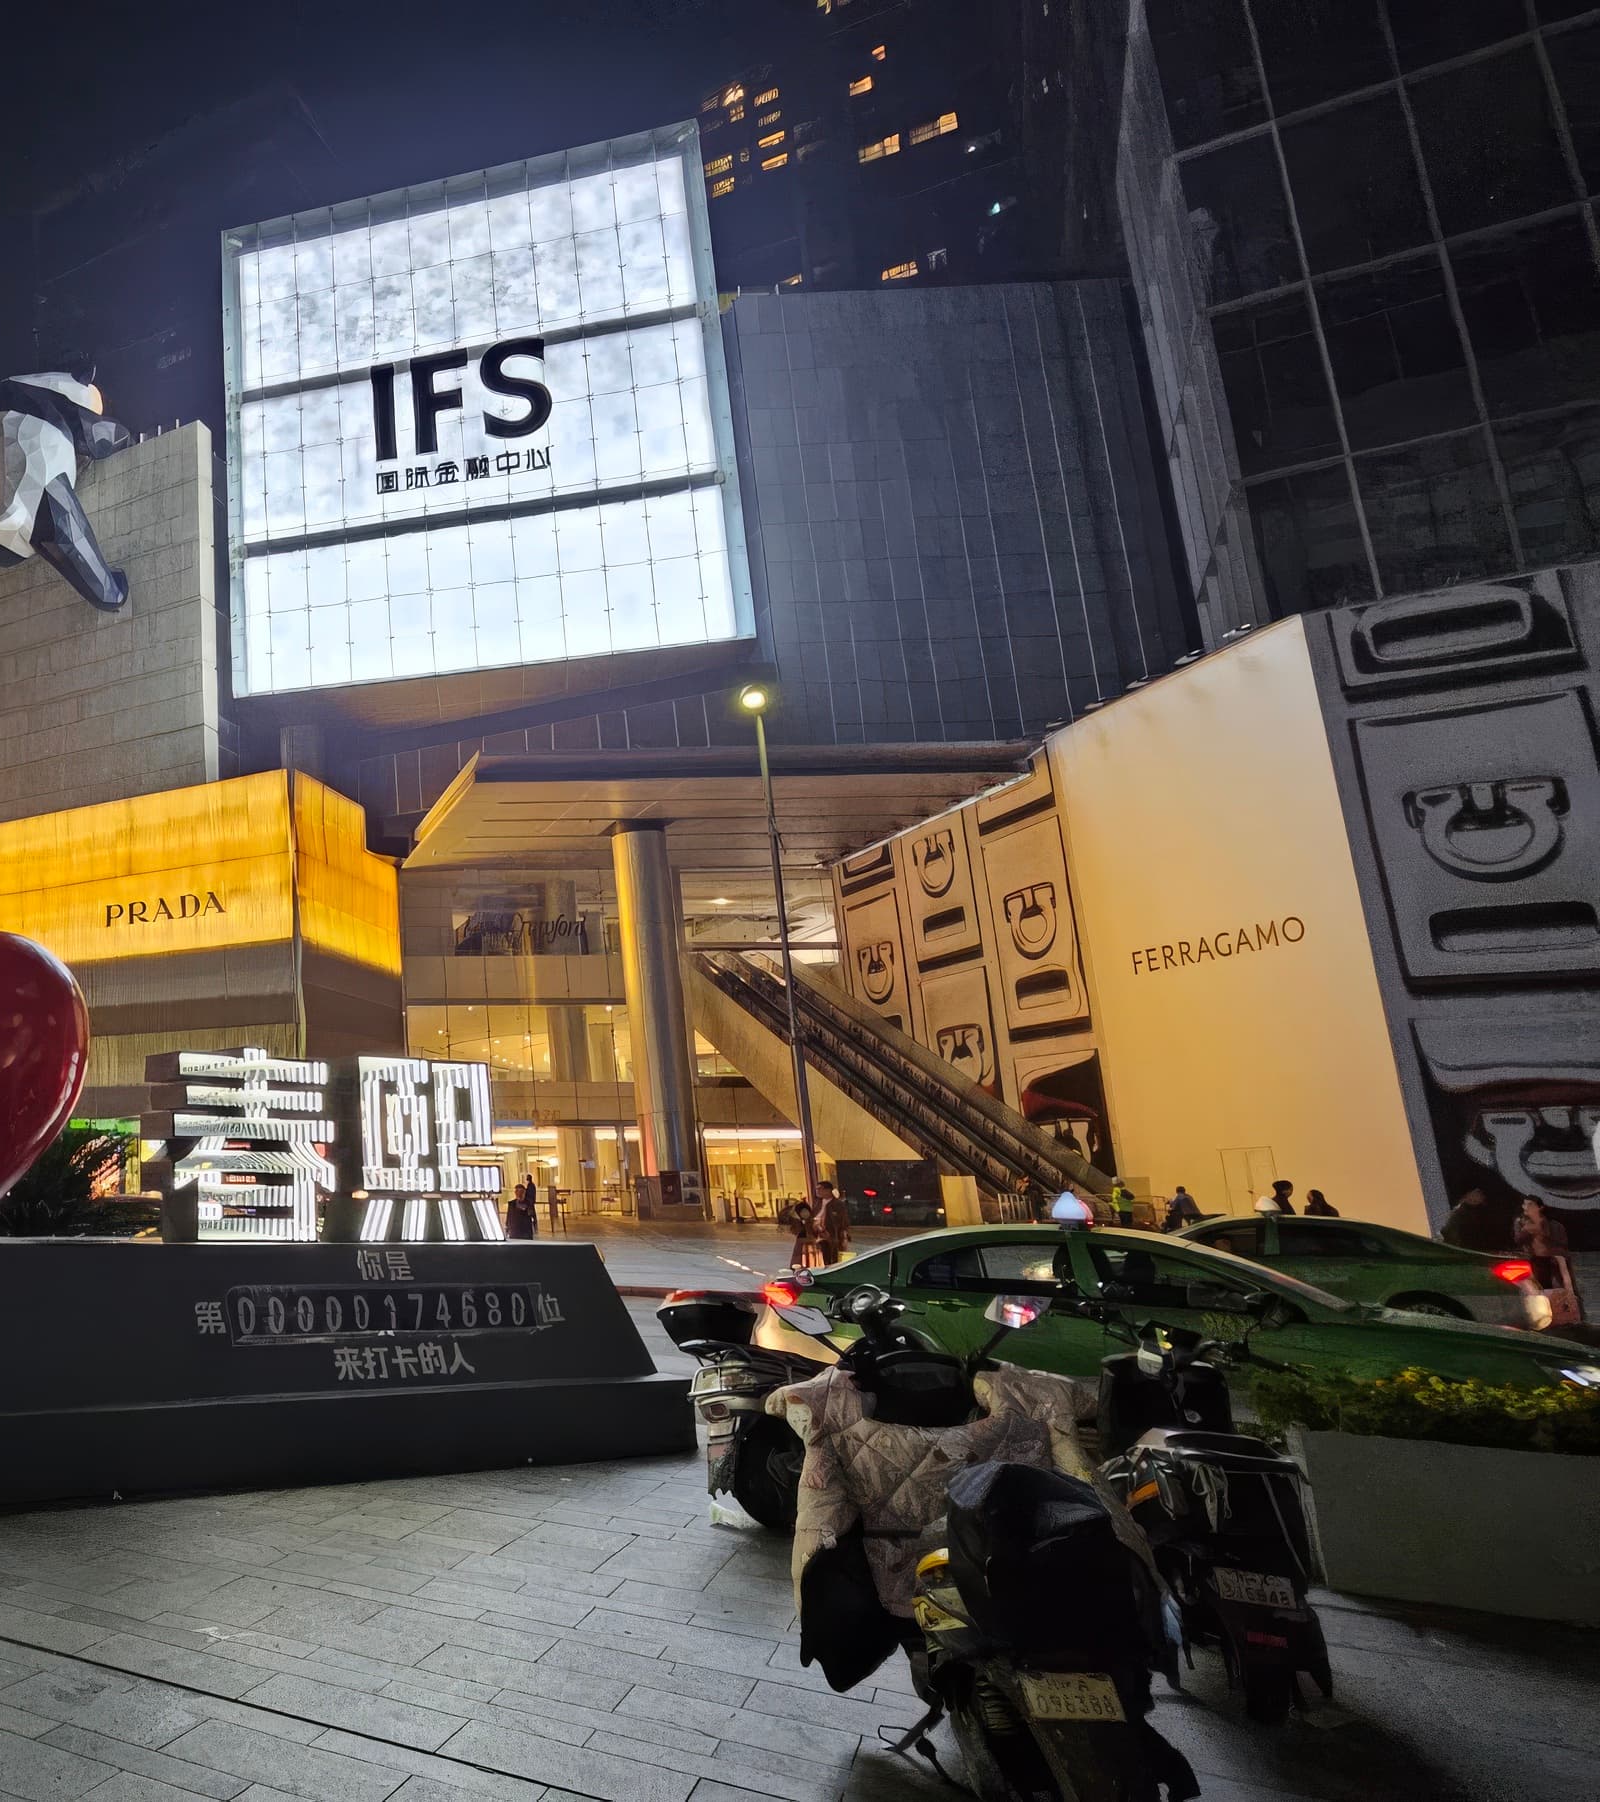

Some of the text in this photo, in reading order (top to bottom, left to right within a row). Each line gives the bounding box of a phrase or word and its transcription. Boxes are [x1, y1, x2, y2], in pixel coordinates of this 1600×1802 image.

[370, 337, 553, 462] IFS
[376, 445, 554, 494] 国际金融中心
[106, 891, 227, 928] PRADA
[1131, 916, 1305, 976] FERRAGAMO
[168, 1046, 507, 1242] 春熙
[356, 1249, 415, 1282] 你是
[195, 1301, 227, 1335] 第
[538, 1293, 567, 1330] 位
[334, 1342, 476, 1382] 来打卡的人
